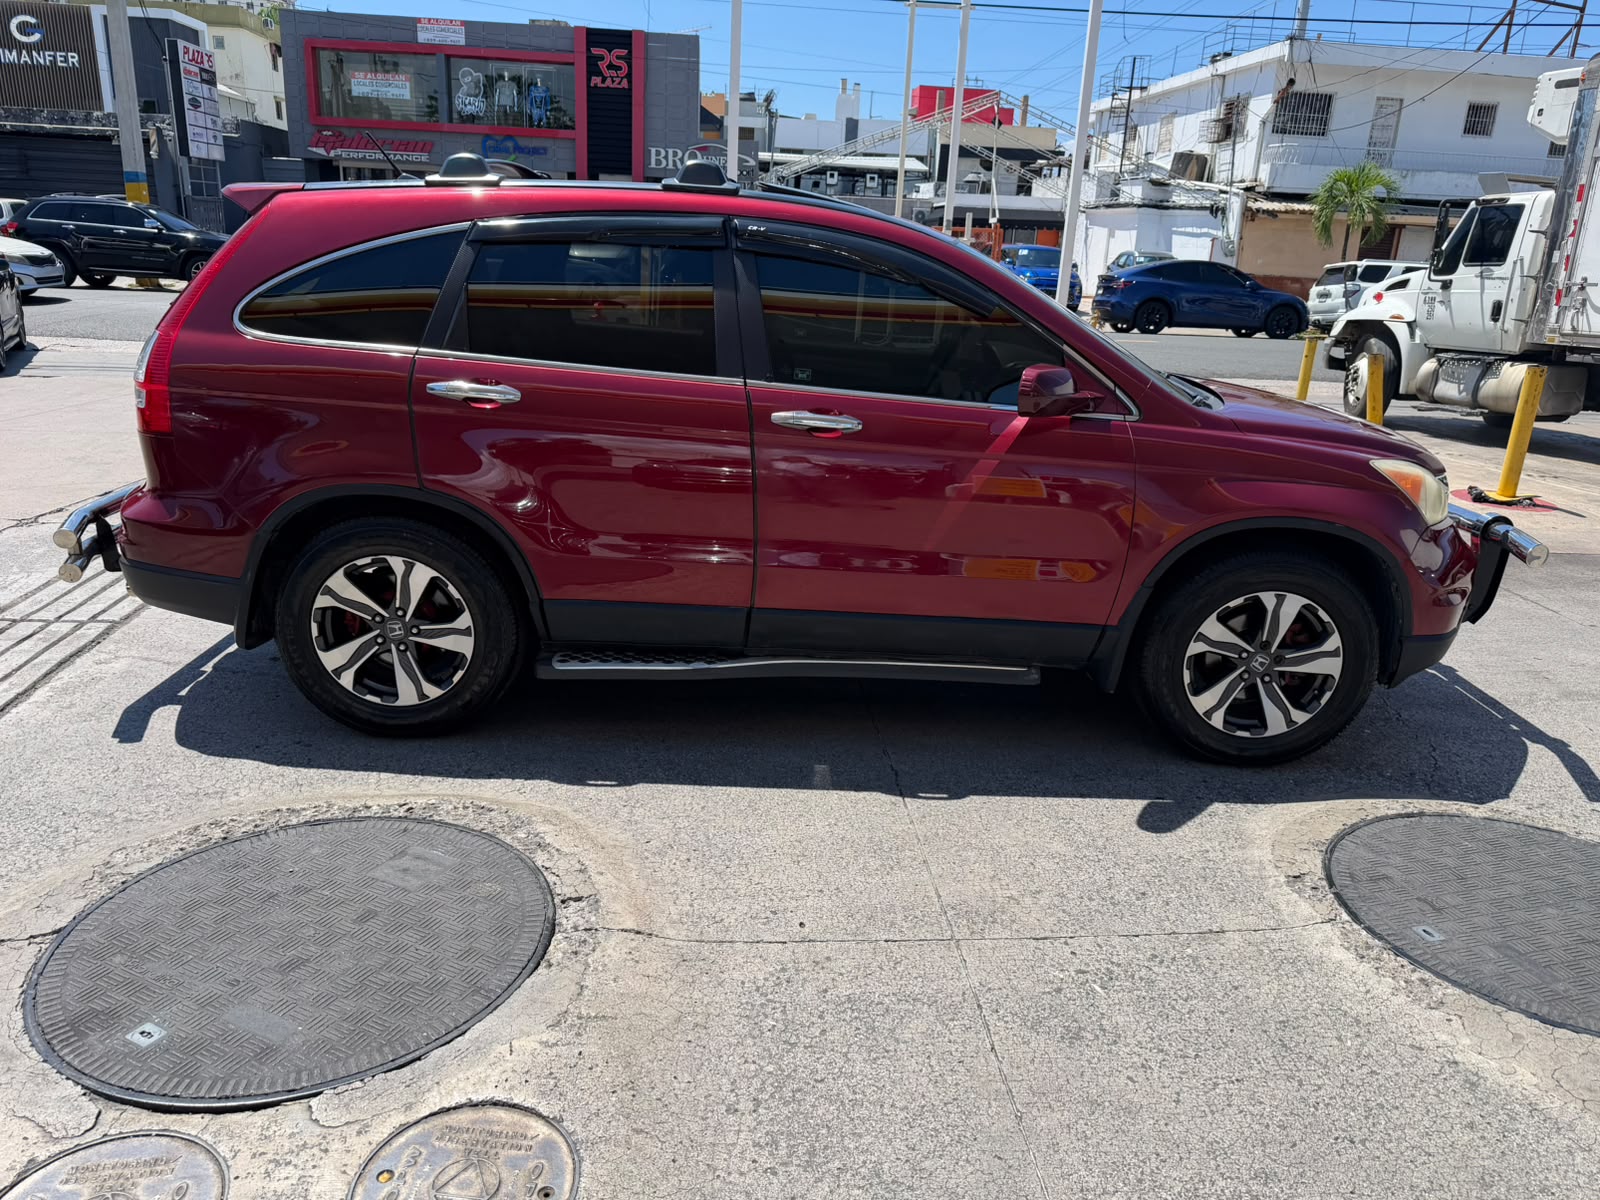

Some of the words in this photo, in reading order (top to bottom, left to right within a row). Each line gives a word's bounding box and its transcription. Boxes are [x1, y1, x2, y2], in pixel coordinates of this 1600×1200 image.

[430, 18, 461, 26] ALQUILAN
[183, 45, 205, 66] PLAZA
[367, 72, 406, 81] ALQUILAN
[590, 76, 629, 89] PLAZA
[328, 150, 430, 162] PERFORMANCE
